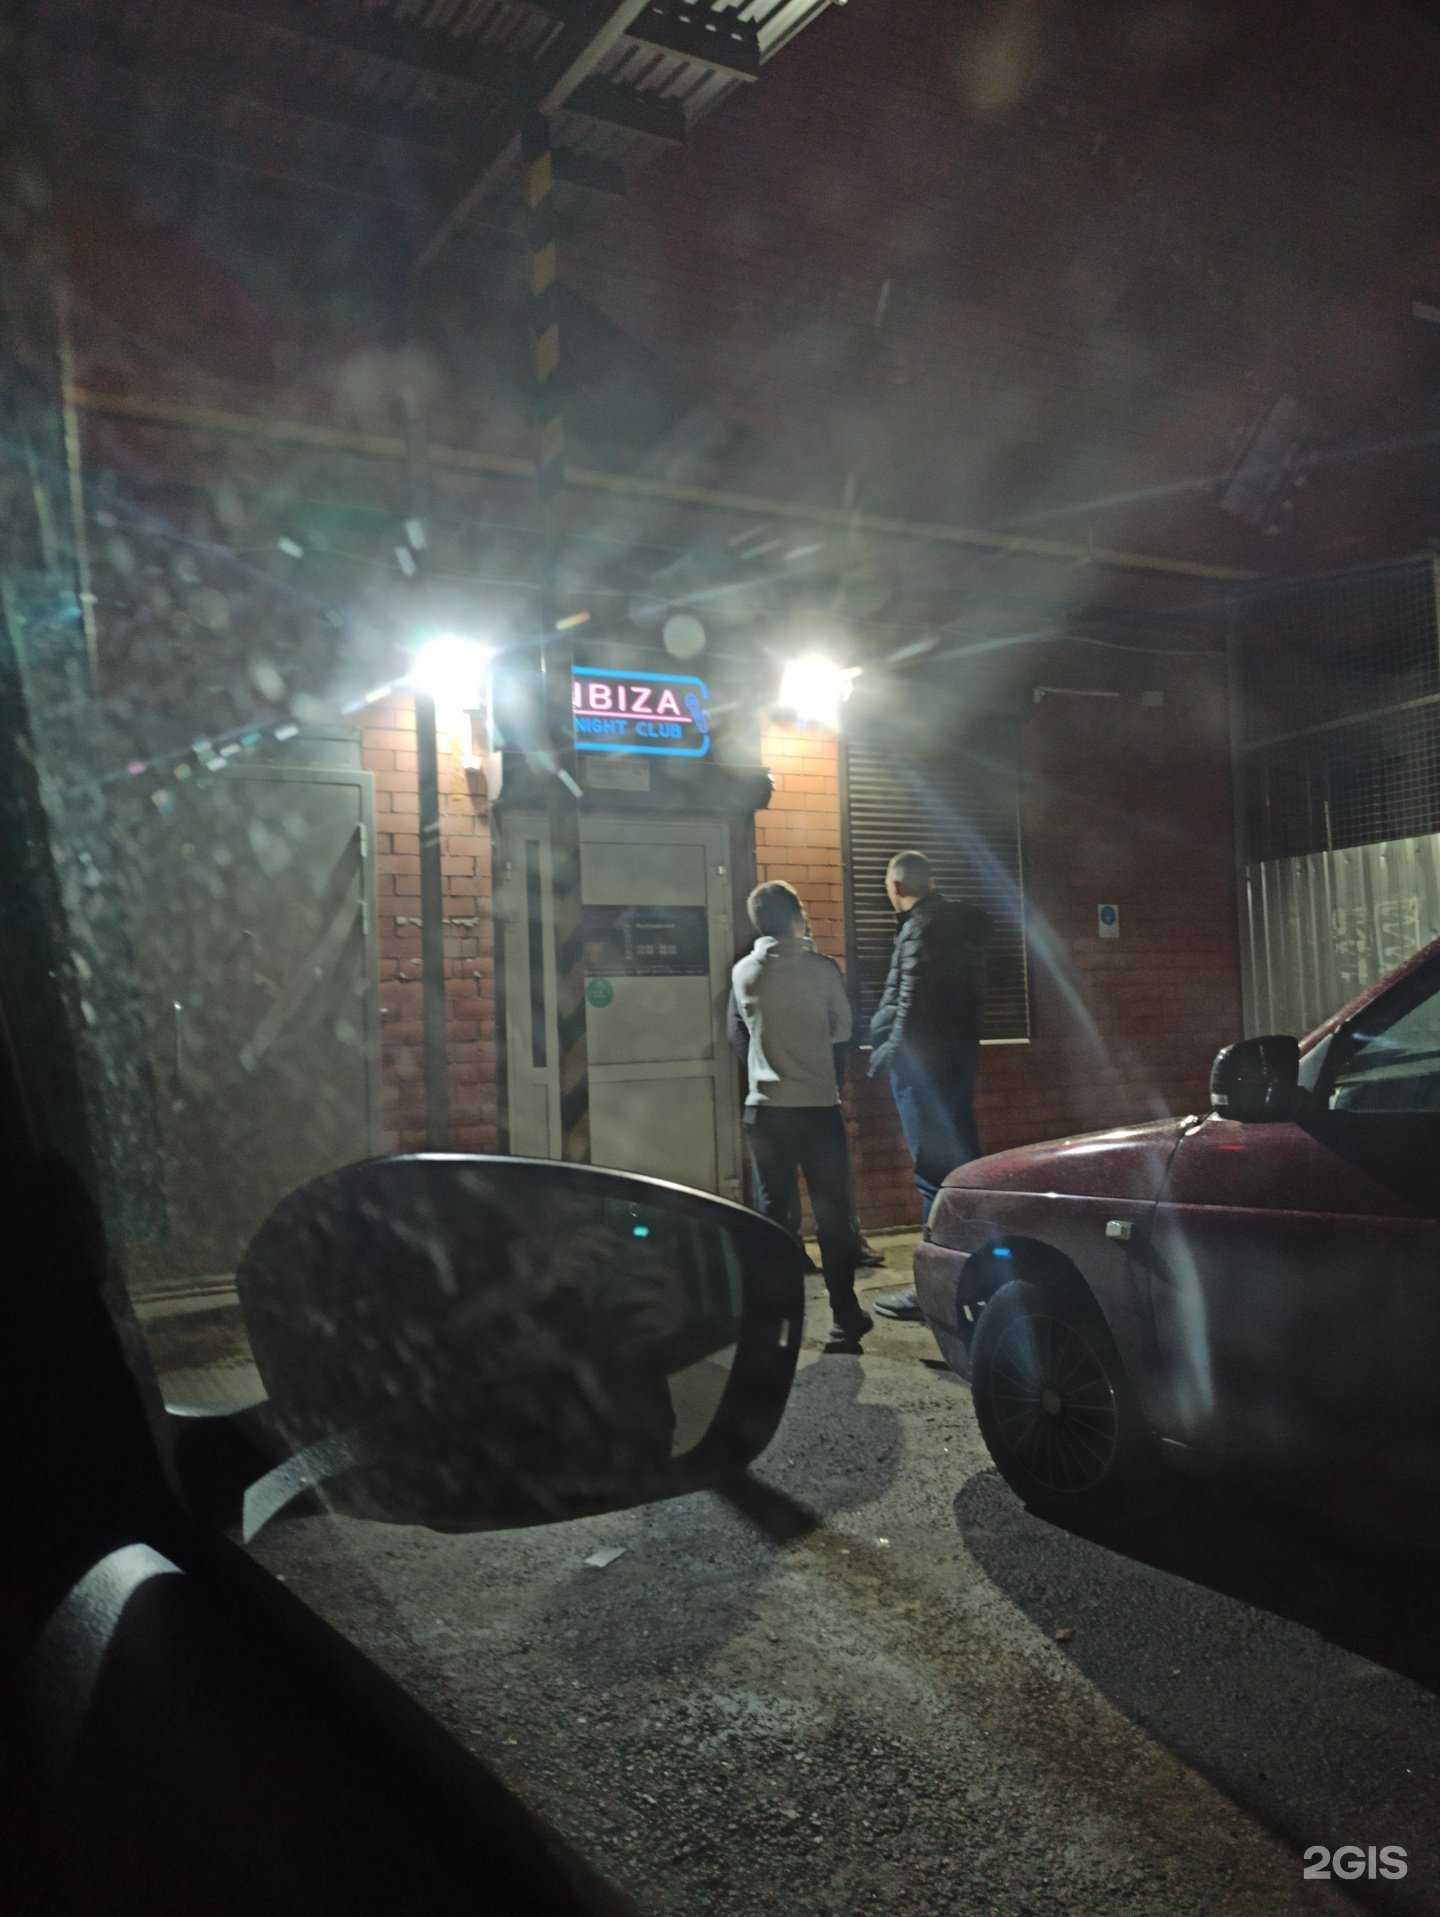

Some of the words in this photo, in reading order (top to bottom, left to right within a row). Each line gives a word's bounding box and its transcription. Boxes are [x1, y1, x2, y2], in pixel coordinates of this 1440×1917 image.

[573, 682, 681, 716] IBIZA
[574, 717, 627, 736] NIGHT
[635, 722, 683, 739] CLUB
